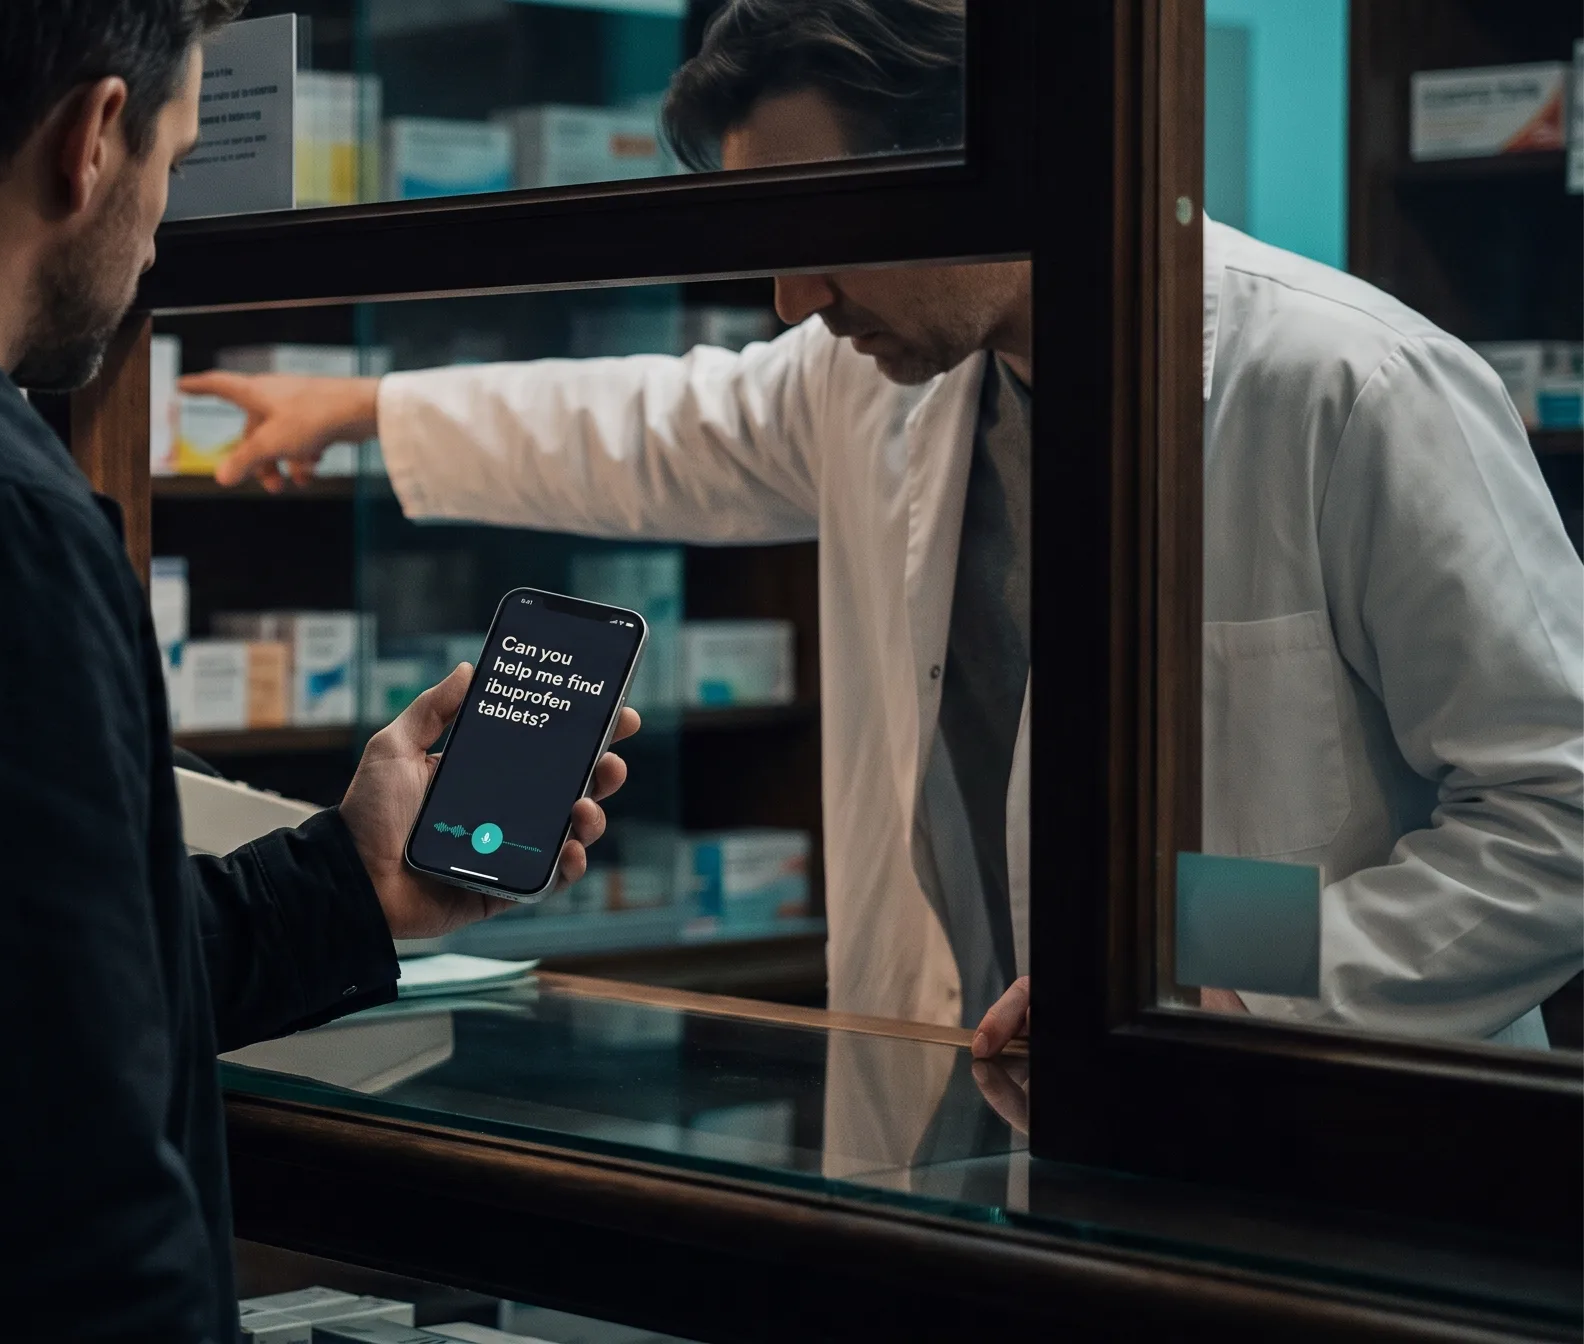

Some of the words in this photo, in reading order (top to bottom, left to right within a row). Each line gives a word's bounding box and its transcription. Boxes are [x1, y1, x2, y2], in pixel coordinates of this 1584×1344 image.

[501, 636, 537, 657] Can
[539, 648, 573, 666] you
[493, 656, 533, 681] help
[535, 670, 564, 686] me
[566, 674, 605, 696] find
[484, 677, 571, 711] ibuprofen
[477, 699, 550, 728] tablets?
